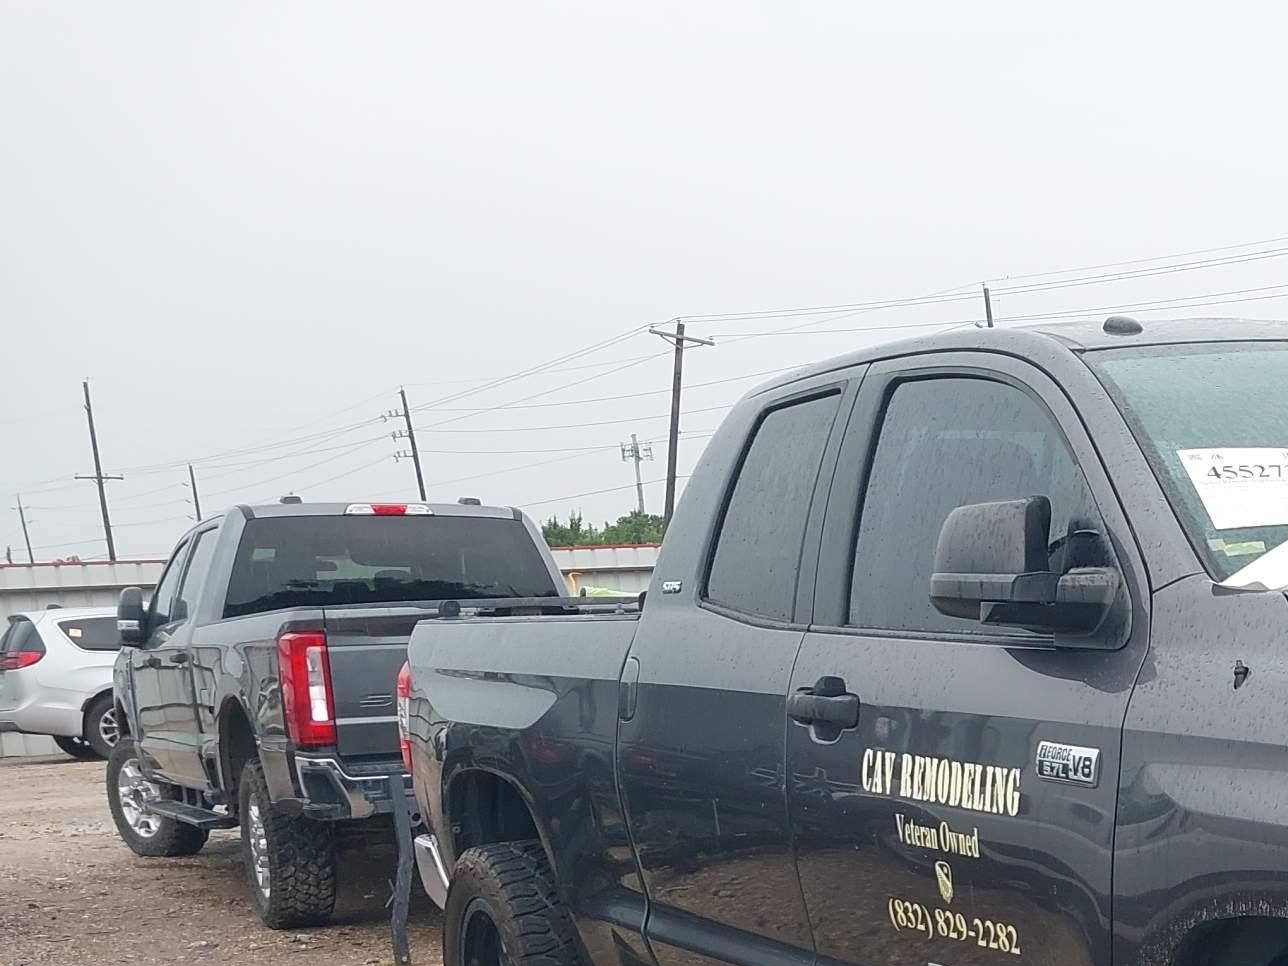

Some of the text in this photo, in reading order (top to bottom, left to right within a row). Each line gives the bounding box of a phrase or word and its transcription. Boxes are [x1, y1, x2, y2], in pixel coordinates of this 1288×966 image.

[861, 748, 1021, 817] CAV REMODELING
[1072, 754, 1093, 779] V8
[895, 813, 980, 859] Veteran Owned
[888, 898, 1022, 955] (832) 829-2282
